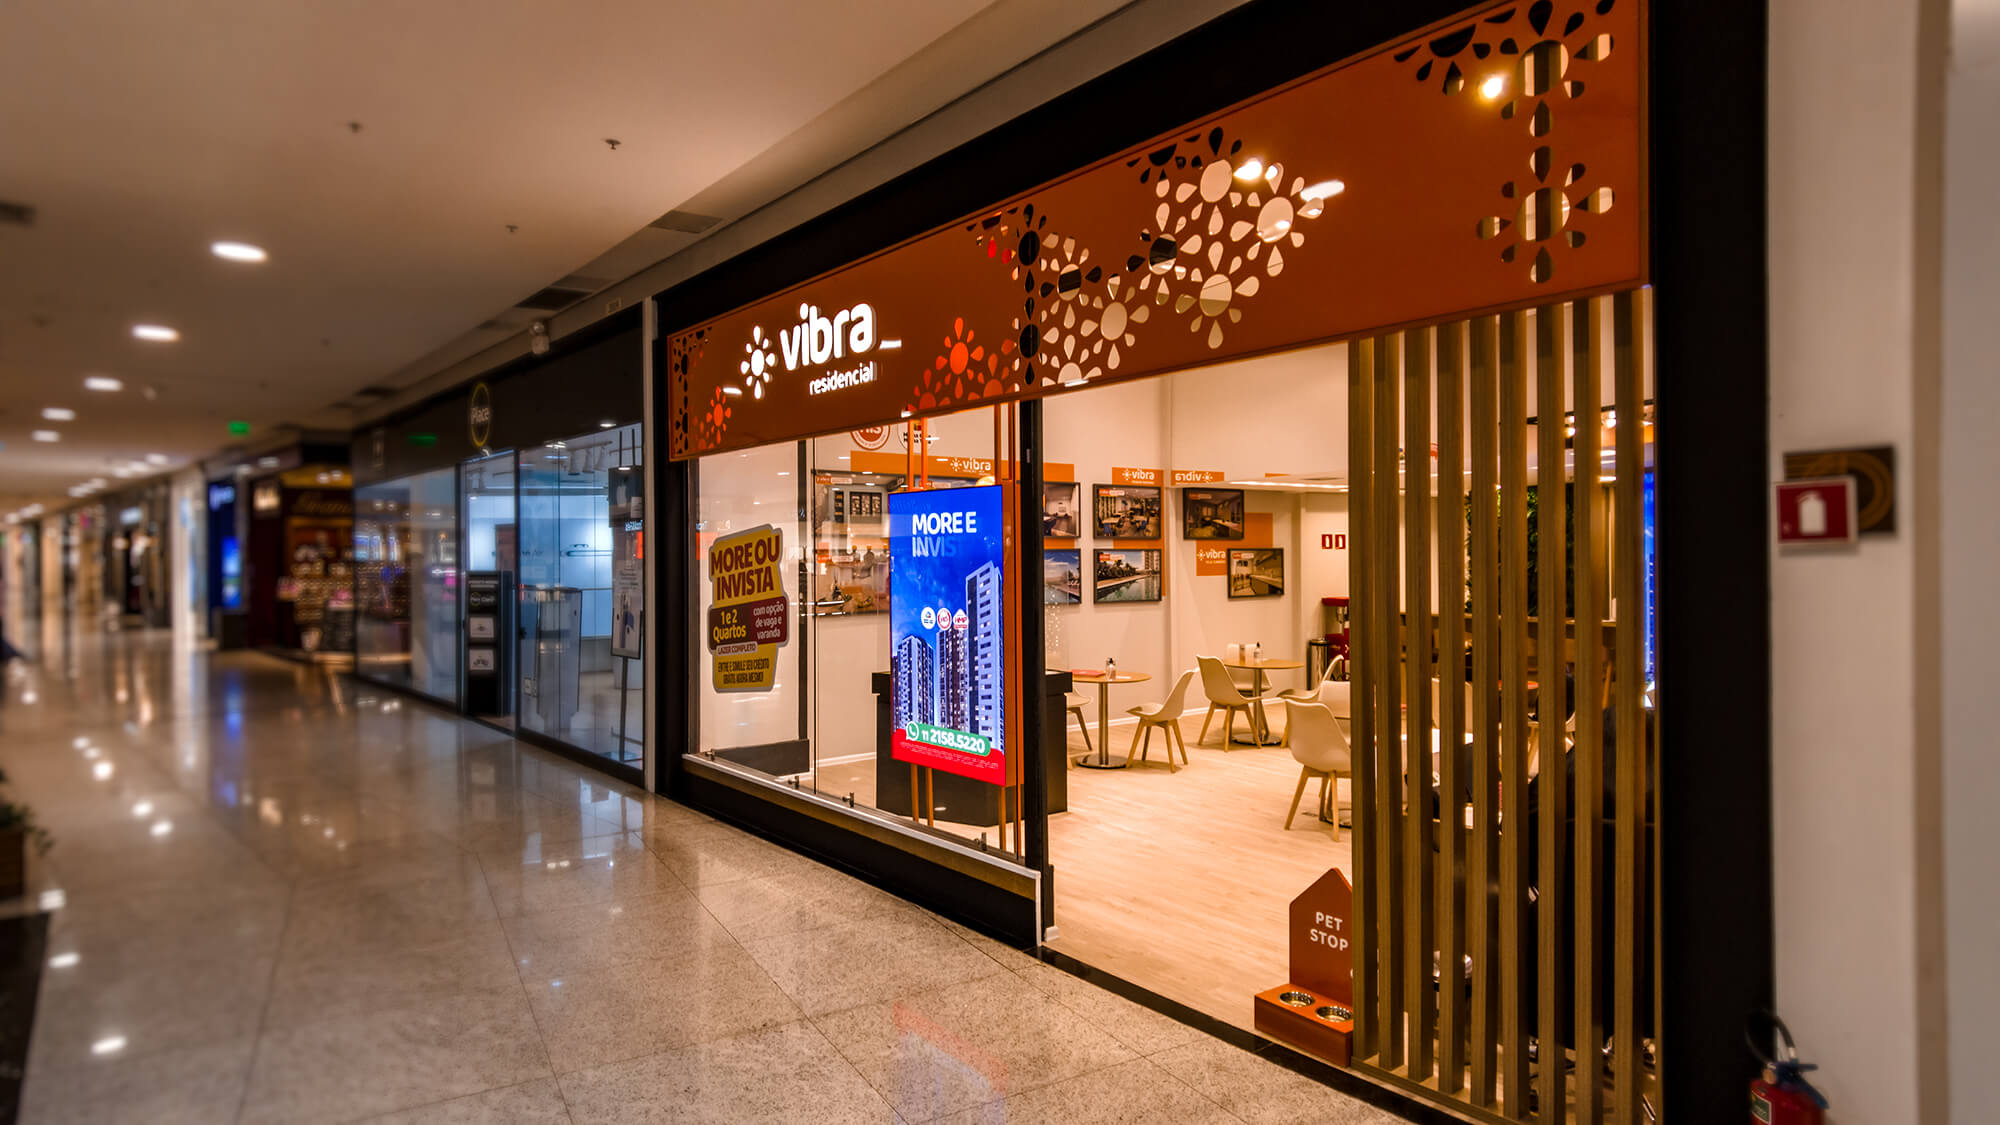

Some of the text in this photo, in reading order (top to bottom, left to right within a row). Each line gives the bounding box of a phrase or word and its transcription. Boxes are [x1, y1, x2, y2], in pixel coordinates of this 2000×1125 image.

[779, 302, 874, 371] vibra
[809, 361, 875, 395] residencial
[962, 457, 992, 471] vibra
[1131, 468, 1155, 480] vibra
[912, 511, 977, 535] MORE E
[711, 535, 780, 577] MORE OU
[1205, 548, 1226, 559] vibra
[716, 565, 774, 601] INVISTA
[721, 609, 738, 624] 1 e 2
[753, 601, 784, 616] com opção
[755, 616, 782, 628] de vaga e
[713, 625, 747, 643] Quartos
[757, 628, 781, 639] varanda
[921, 729, 985, 753] 11 2158.5220
[1315, 911, 1344, 931] PET
[1309, 928, 1349, 951] STOP
